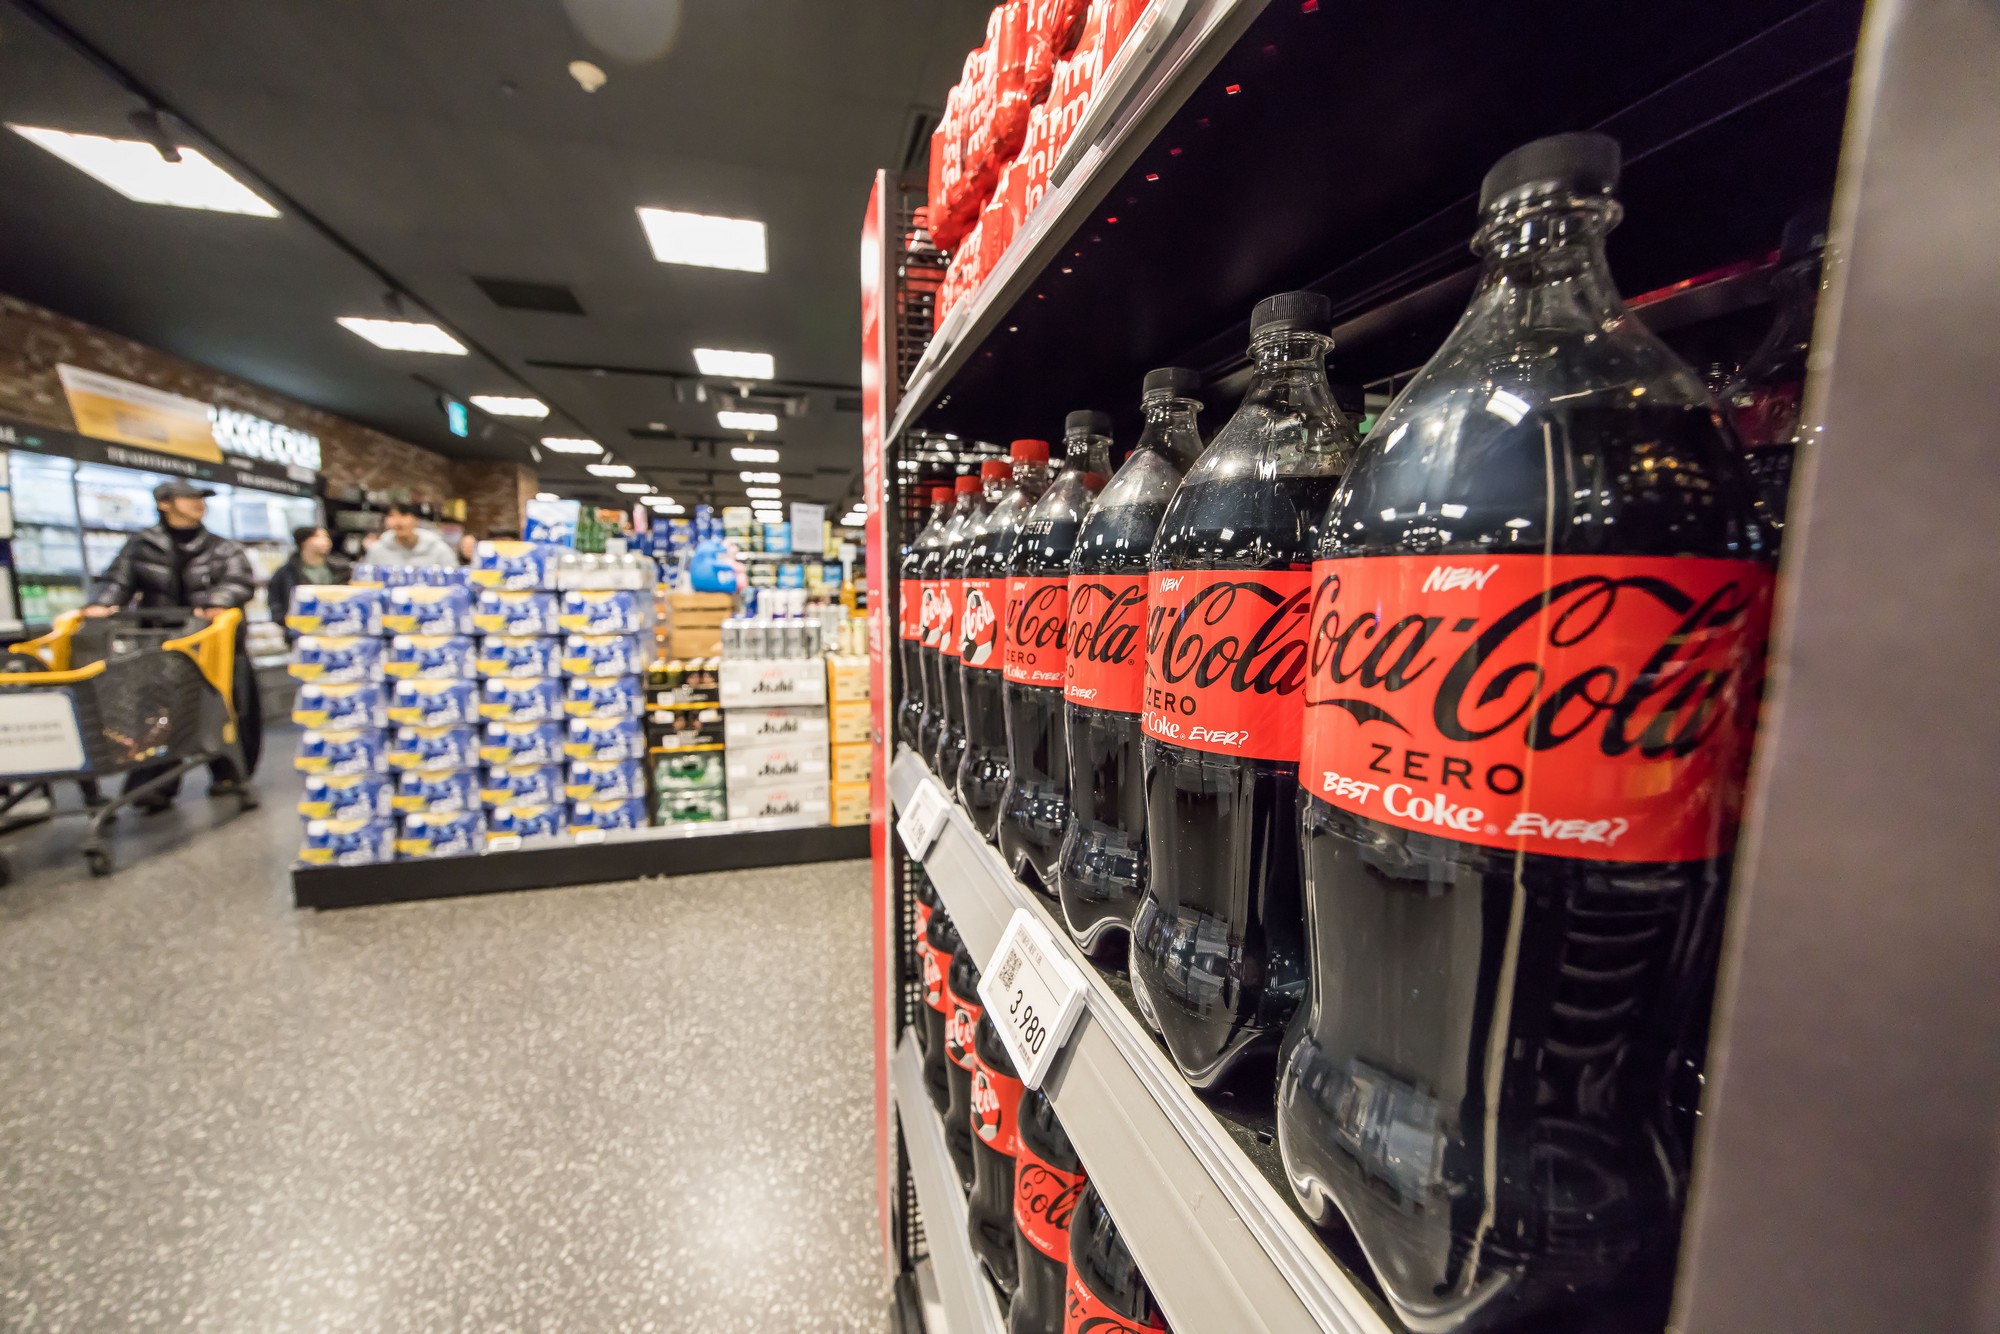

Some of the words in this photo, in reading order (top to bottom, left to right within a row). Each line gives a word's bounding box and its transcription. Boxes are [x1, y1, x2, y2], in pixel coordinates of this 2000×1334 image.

[1159, 575, 1185, 593] NEW
[1421, 564, 1500, 594] NEW
[1145, 686, 1197, 716] ZERO
[1148, 711, 1181, 739] Coke
[1188, 726, 1249, 748] EVER?
[1369, 742, 1525, 796] ZERO
[1322, 771, 1380, 805] BEST
[1382, 783, 1485, 834] Coke
[1505, 812, 1630, 845] EVER?
[1010, 989, 1046, 1055] 3,980
